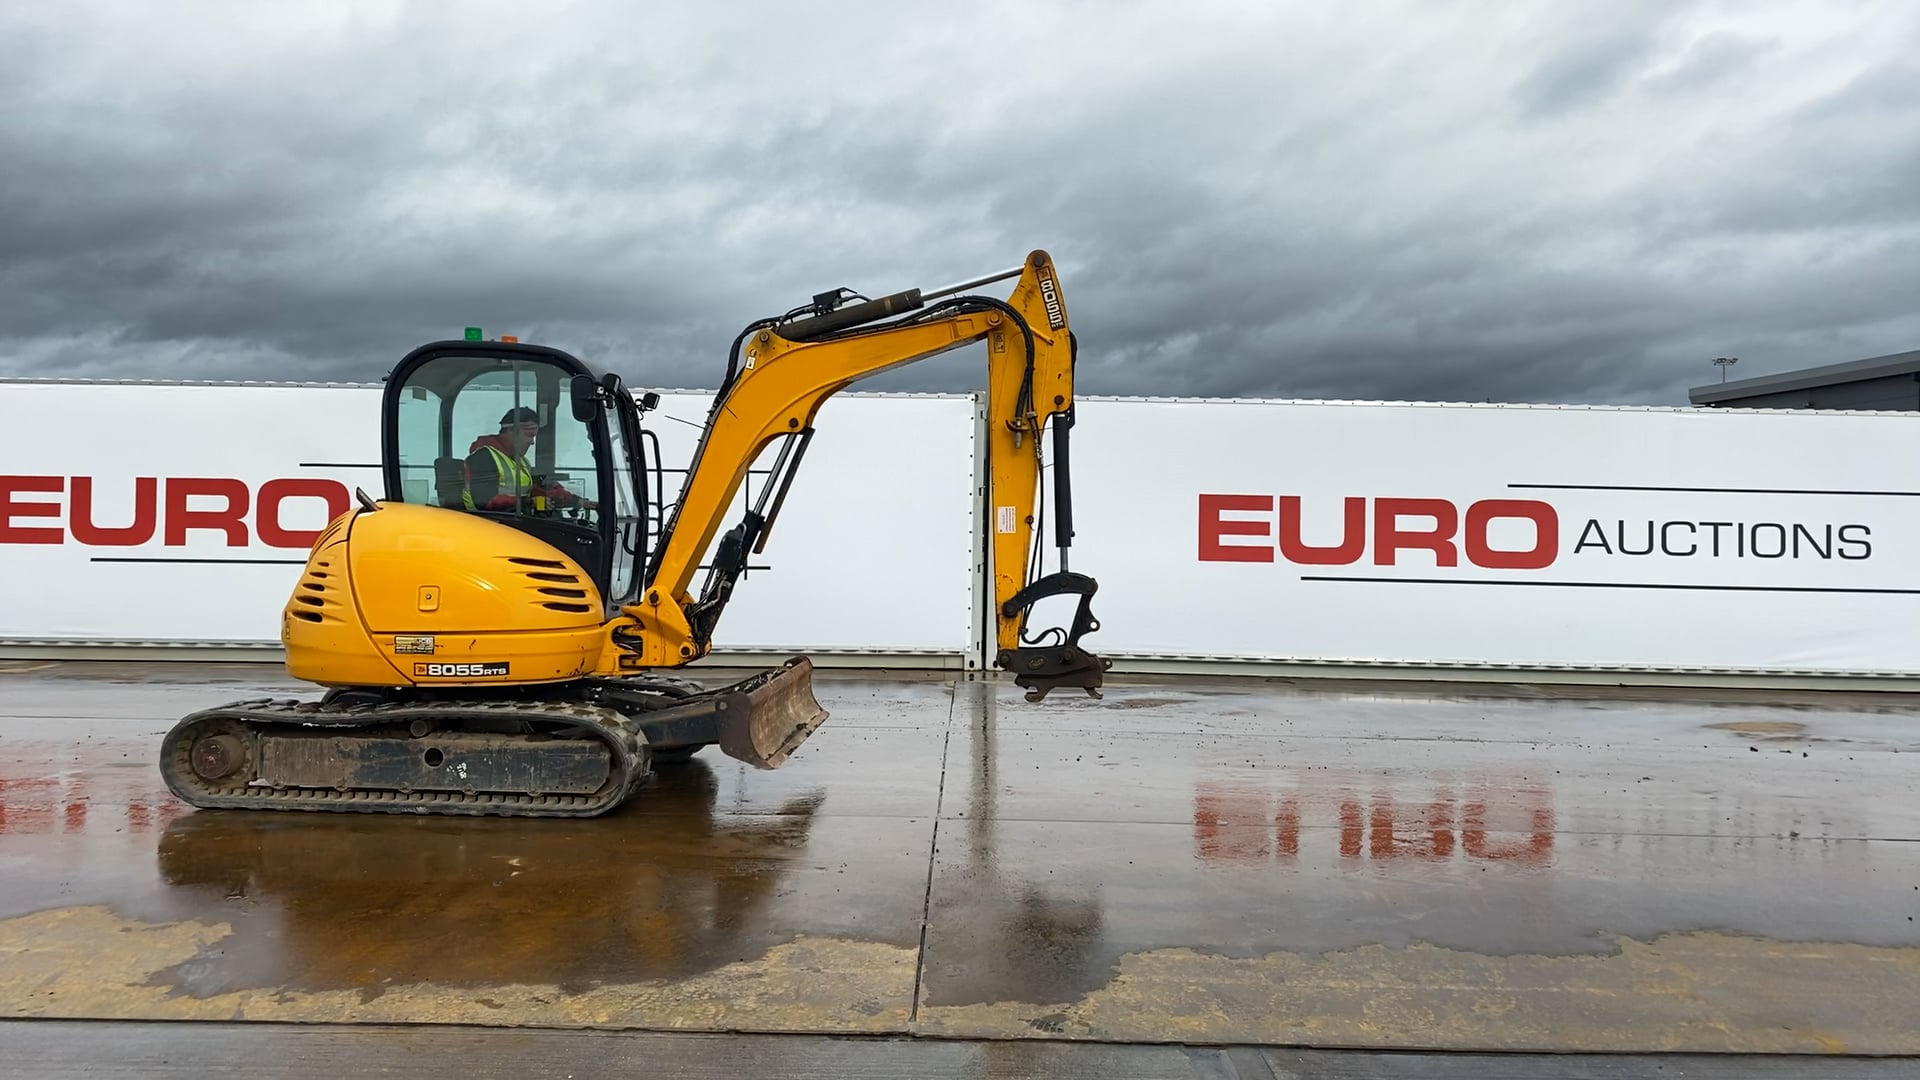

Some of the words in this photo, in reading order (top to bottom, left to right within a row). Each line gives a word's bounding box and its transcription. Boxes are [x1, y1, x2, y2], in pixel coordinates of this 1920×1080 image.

[1041, 279, 1063, 323] 8055
[0, 475, 350, 549] EURO
[1198, 494, 1559, 569] EURO
[1573, 519, 1873, 560] AUCTIONS
